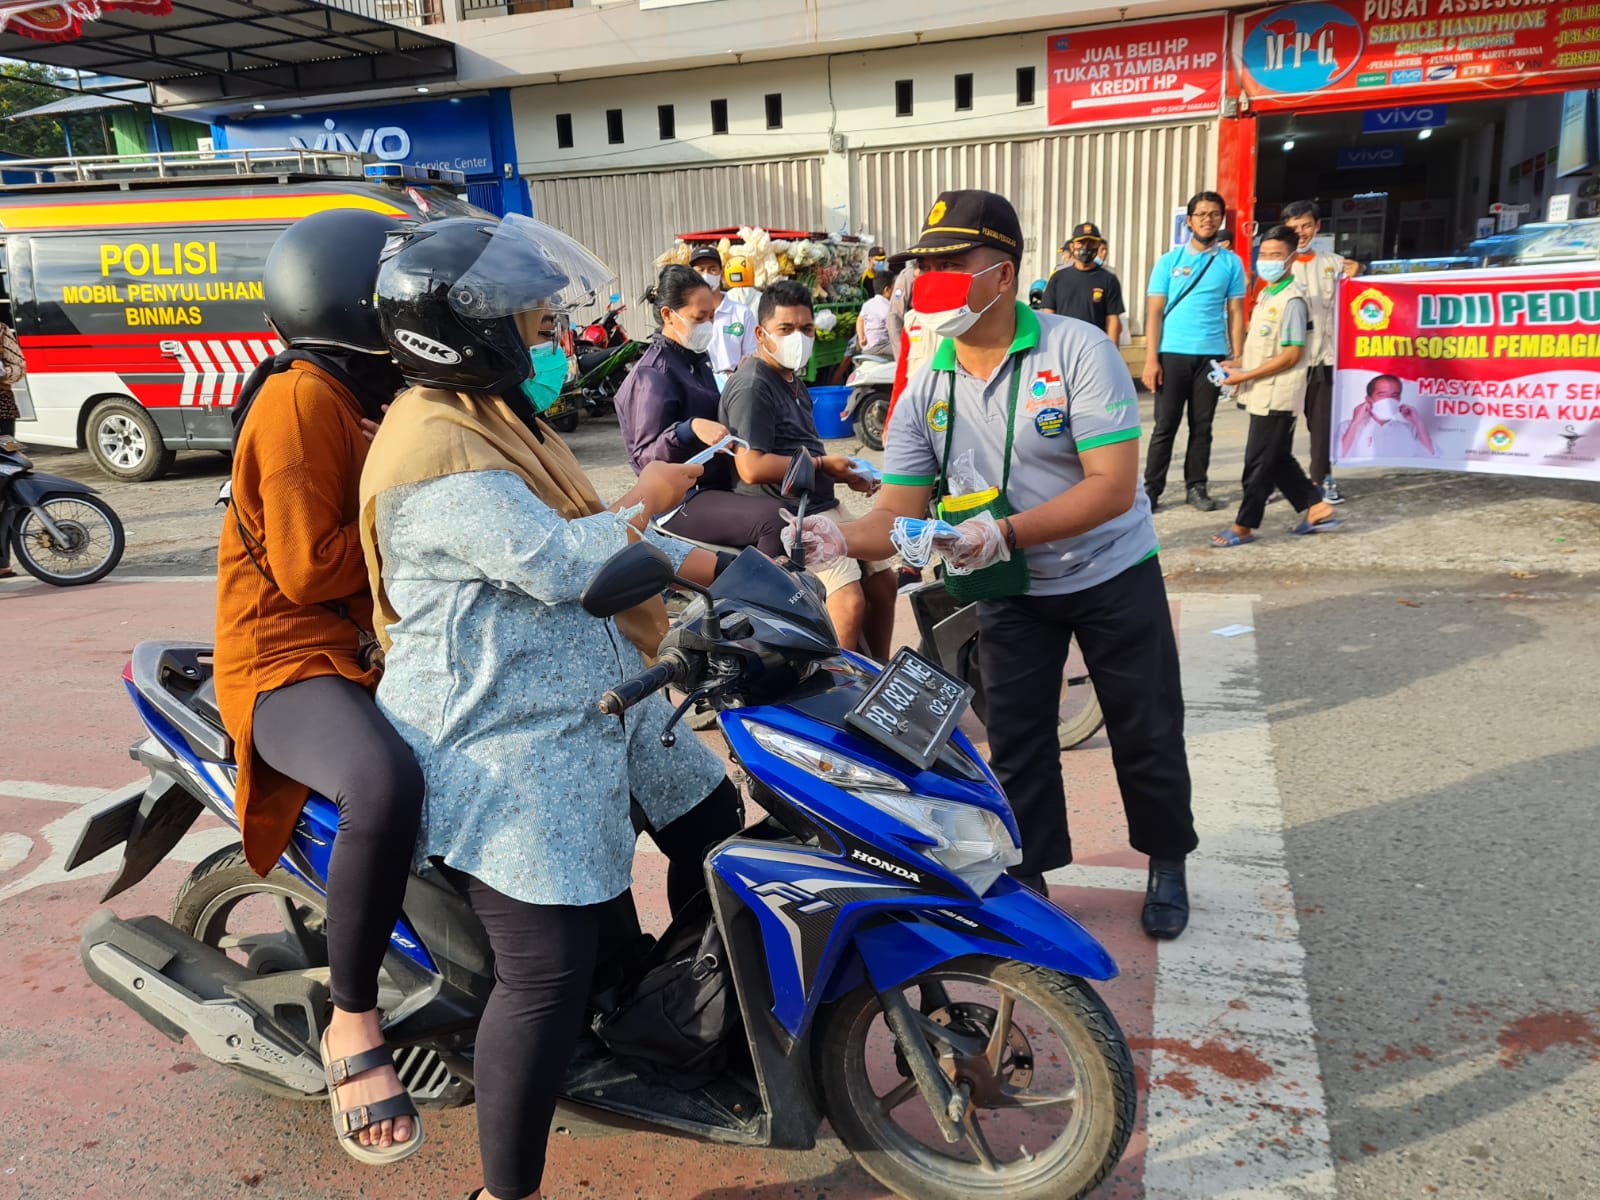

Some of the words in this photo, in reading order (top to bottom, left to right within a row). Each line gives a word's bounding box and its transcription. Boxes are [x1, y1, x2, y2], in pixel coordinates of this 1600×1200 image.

[1368, 21, 1438, 45] SERVICE
[1440, 9, 1547, 37] HANDPHONE
[1081, 45, 1123, 64] JUAL
[1127, 41, 1161, 59] BELI
[1164, 37, 1188, 54] HP
[1264, 29, 1335, 71] MPG
[1054, 64, 1109, 83] TUKAR
[1113, 54, 1189, 77] TAMBAH
[1192, 52, 1217, 69] HP
[1091, 76, 1151, 97] KREDIT
[1153, 74, 1178, 91] HP
[455, 157, 488, 169] Center
[100, 241, 218, 277] POLISI
[63, 285, 124, 304] MOBIL
[128, 281, 263, 303] PENYULUHAN
[125, 306, 202, 326] BINMAS
[1418, 293, 1494, 328] LDII
[1500, 288, 1600, 327] PEDU
[401, 333, 450, 359] INK
[1355, 335, 1413, 357] BAKTI
[1415, 335, 1489, 359] SOSIAL
[1418, 378, 1559, 400] MASYARAKAT
[1435, 400, 1549, 420] INDONESIA
[1558, 404, 1600, 421] KUA
[900, 659, 932, 684] ME
[881, 677, 919, 712] 4821
[865, 705, 898, 733] PB
[851, 849, 921, 883] HONDA
